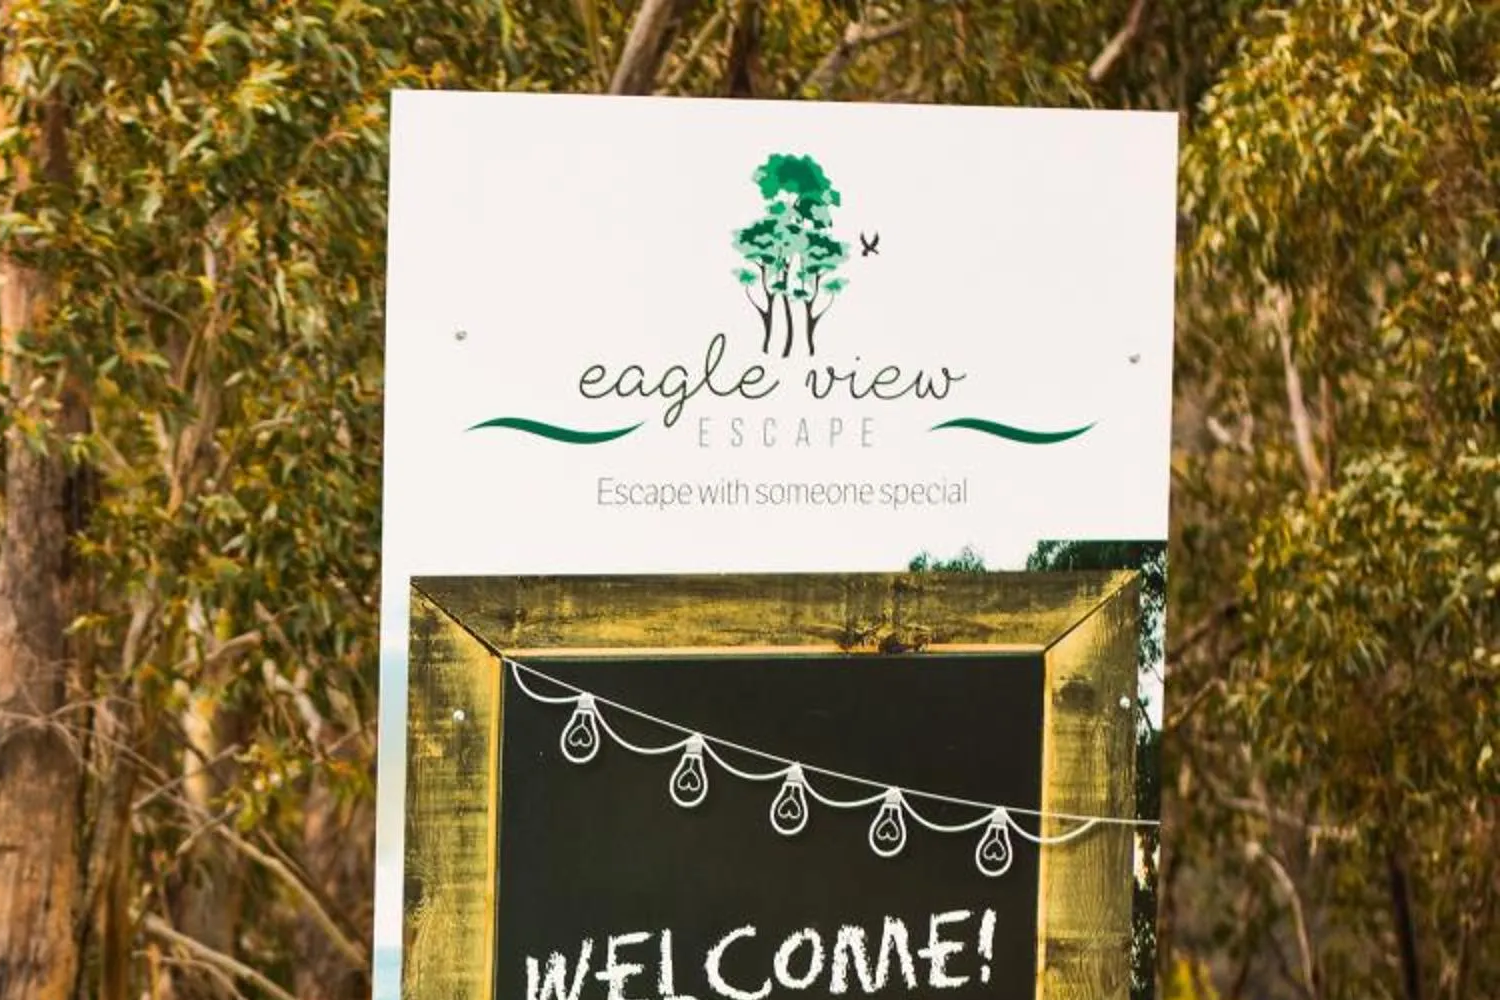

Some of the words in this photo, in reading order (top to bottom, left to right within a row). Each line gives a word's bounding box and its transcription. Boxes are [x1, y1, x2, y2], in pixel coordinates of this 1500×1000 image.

[579, 333, 779, 427] eagle
[805, 355, 967, 401] view
[699, 416, 874, 448] ESCAPE
[597, 476, 694, 510] Escape
[699, 477, 750, 505] with
[755, 481, 875, 506] someone
[880, 477, 967, 510] special
